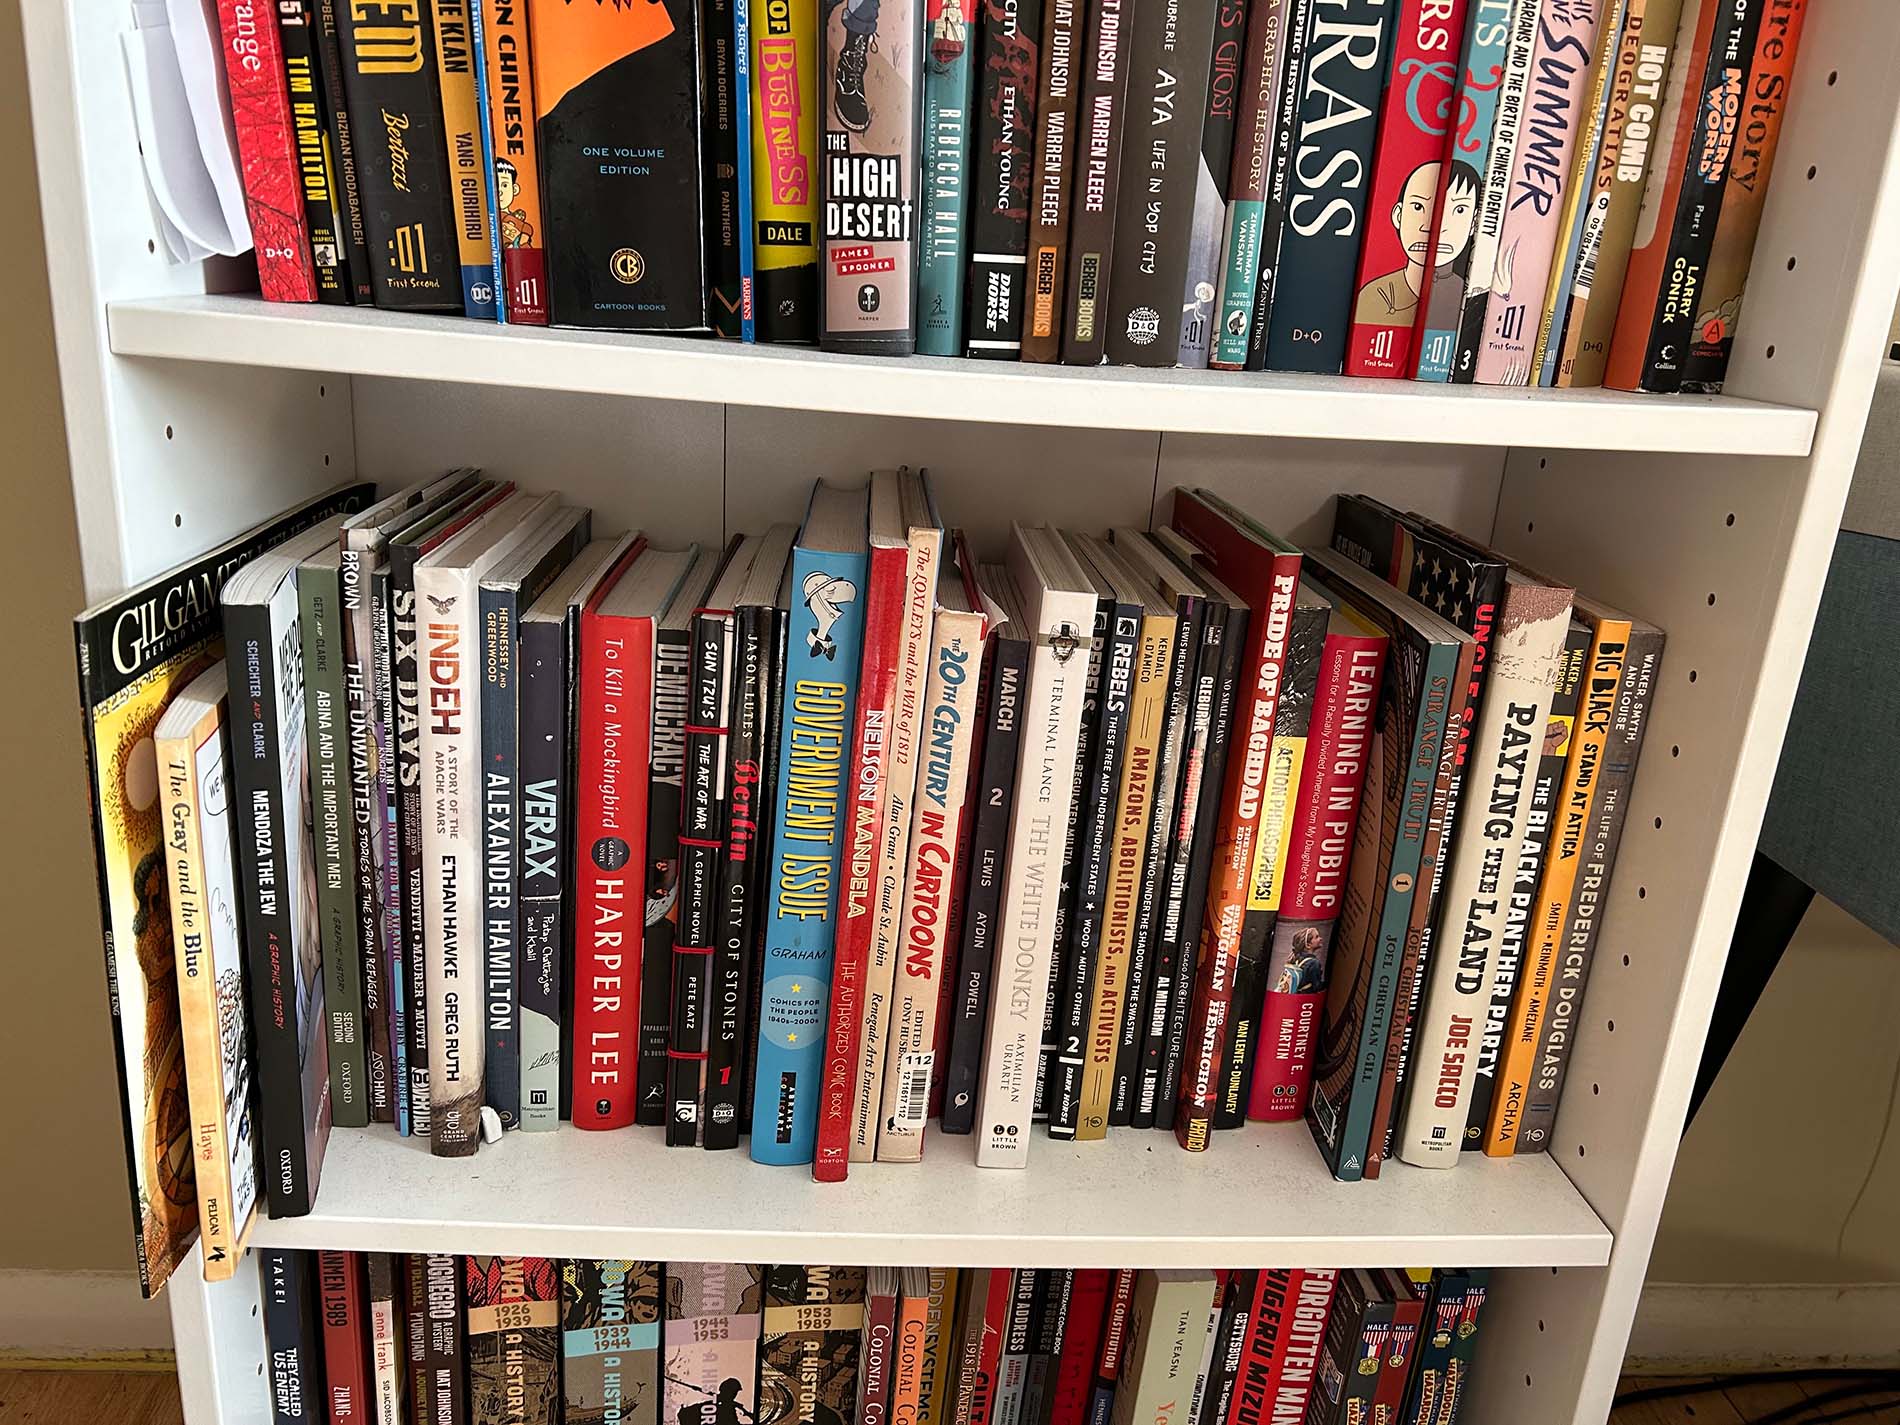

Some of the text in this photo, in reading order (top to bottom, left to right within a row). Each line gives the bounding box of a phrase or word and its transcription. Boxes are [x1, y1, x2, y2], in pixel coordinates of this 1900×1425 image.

[287, 56, 328, 202] TIM HAMILTON
[497, 35, 524, 156] CHINESE
[1150, 68, 1176, 126] AYA
[1599, 16, 1642, 188] DEOGRATIAS
[1617, 44, 1669, 184] HOT COMB
[1699, 84, 1724, 175] WORLD
[1708, 67, 1742, 183] MODERN
[583, 147, 664, 158] ONE VOLUME
[599, 166, 650, 175] EDITION
[827, 134, 847, 150] THE
[999, 87, 1015, 210] ETHAN YOUNG
[1040, 112, 1065, 226] WARREN PLEECE
[1085, 95, 1112, 212] WARREN PLEECE
[1152, 141, 1166, 170] LIFE
[337, 112, 364, 245] BIZHAN KHODABANDEH
[456, 132, 483, 241] YANG GURIHIRU
[832, 158, 897, 198] HIGH
[934, 108, 962, 257] REBECCA HALL
[1149, 178, 1161, 191] IN
[768, 227, 802, 241] DALE
[827, 200, 912, 241] DESERT
[835, 248, 868, 258] JAMES
[1235, 220, 1248, 272] VANSANT
[1244, 212, 1258, 283] ZIMMERMAN
[841, 262, 890, 272] SPOONER
[1141, 241, 1156, 273] CITY
[1663, 258, 1685, 323] GONICK
[1680, 265, 1699, 317] LARRY
[986, 272, 999, 331] HORSE
[998, 274, 1011, 322] DARK
[342, 551, 359, 608] BROWN
[487, 613, 497, 682] GREENWOOD
[498, 608, 508, 674] HENNESSEY
[1140, 645, 1155, 682] D'AMICO
[1154, 638, 1168, 679] KENDALL
[428, 624, 460, 735] INDEH
[702, 642, 718, 719] SUN TZU'S
[742, 634, 758, 738] JASON LUTES
[997, 666, 1019, 732] MARCH
[1107, 642, 1132, 712] REBELS
[1238, 575, 1294, 820] PRIDE OF BAGHDAD
[347, 662, 370, 825] THE UNWANTED
[599, 639, 624, 828] To Kill a Mockingbird
[1040, 677, 1064, 803] TERMINAL LANCE
[1560, 642, 1624, 860] BIG BLACK STAND AT ATTICA
[316, 690, 342, 889] ABINA AND THE IMPORTANT MEN
[730, 760, 760, 861] Berlin
[778, 680, 846, 921] GOVERNMENT ISSUE
[848, 709, 885, 919] NELSON MANDELA
[906, 647, 968, 979] 20TH CENTURY IN CARTOONS
[990, 788, 1003, 805] 2
[1312, 651, 1378, 908] LEARNING IN PUBLIC
[252, 790, 278, 916] MENDOZA THE JEW
[525, 779, 557, 879] VERAX
[1455, 702, 1538, 995] PAYING THE LAND
[167, 760, 199, 978] The Gray and the Blue
[487, 773, 511, 1030] ALEXANDER HAMILTON
[442, 856, 457, 979] ETHAN HAWKE
[966, 850, 995, 1019] LEWIS AYDIN POWELL
[1010, 816, 1050, 1020] THE WHITE DONKEY
[1094, 746, 1150, 1064] AMAZONS, ABOLITIONISTS, AND ACTIVISTS
[1477, 777, 1552, 1079] THE BLACK PANTHER PARTY
[1538, 790, 1617, 1090] THE LIFE OF FREDERICK DOUGLASS
[591, 879, 624, 1084] HARPER LEE
[722, 885, 743, 1040] CITY OF STONES
[771, 947, 826, 960] GRAHAM
[334, 1012, 344, 1044] EDITION
[345, 1012, 353, 1043] SECOND
[445, 992, 459, 1082] GREG RUTH
[686, 1005, 695, 1029] KATZ
[770, 998, 801, 1006] COMICS
[906, 1055, 932, 1065] 112
[1276, 1018, 1293, 1060] MARTIN
[1291, 1002, 1313, 1074] COURTNEY E.
[1434, 1015, 1473, 1109] JOE SACCO
[341, 1062, 352, 1103] OXFORD
[719, 1066, 731, 1085] 1
[1499, 1082, 1522, 1142] ARCHAIA
[279, 1149, 292, 1195] OXFORD
[207, 1198, 219, 1236] PELICAN
[272, 1258, 286, 1303] TAKEI
[494, 1304, 530, 1318] 1926
[797, 1308, 832, 1319] 1953
[496, 1316, 532, 1329] 1939
[593, 1326, 629, 1339] 1939
[594, 1338, 631, 1351] 1944
[692, 1317, 729, 1330] 1944
[694, 1329, 729, 1341] 1953
[797, 1319, 832, 1330] 1989
[1169, 1311, 1189, 1379] TIAN VEASNA
[505, 1334, 525, 1416] A HISTORY
[867, 1324, 890, 1395] COLONIAL
[899, 1320, 924, 1396] COLONIAL
